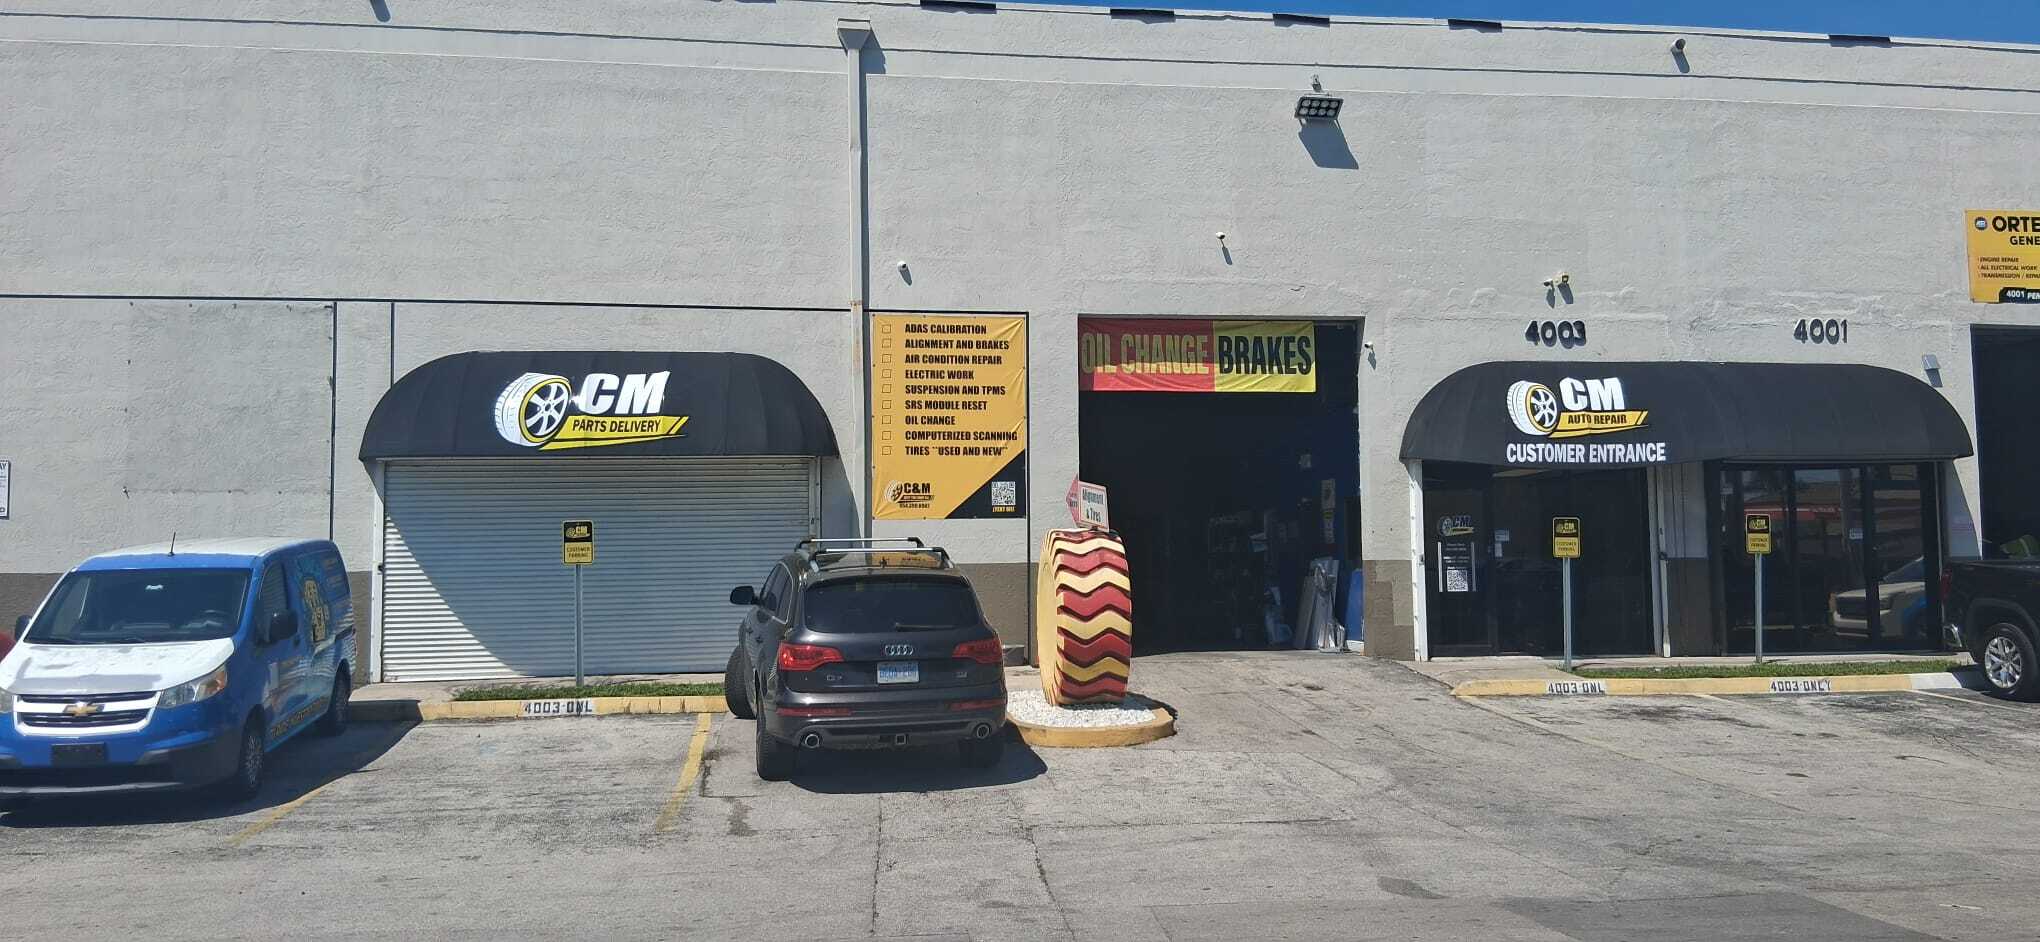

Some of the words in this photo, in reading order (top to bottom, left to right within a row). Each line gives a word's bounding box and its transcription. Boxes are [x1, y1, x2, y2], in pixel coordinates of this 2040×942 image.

[1992, 216, 2040, 232] ORTE
[2010, 236, 2040, 246] GENE
[2006, 290, 2025, 298] 4001
[905, 324, 929, 334] ADAS
[930, 324, 987, 334] CALIBRATION
[1524, 319, 1587, 350] 4003
[1793, 318, 1848, 345] 4001
[905, 339, 954, 349] ALIGNMENT
[956, 339, 974, 349] AND
[976, 340, 1009, 350] BRAKES
[1081, 332, 1117, 373] OIL
[1120, 334, 1209, 375] CHANGE
[1218, 335, 1312, 375] BRAKES
[905, 355, 920, 364] AIR
[922, 355, 970, 364] CONDITION
[972, 356, 1002, 365] REPAIR
[905, 370, 945, 379] ELECTRIC
[947, 370, 974, 379] WORK
[578, 371, 671, 415] CM
[905, 385, 960, 395] SUSPENSION
[962, 385, 980, 395] AND
[981, 385, 1006, 395] TPMS
[1559, 376, 1625, 411] CM
[905, 400, 923, 410] SRS
[924, 400, 960, 410] MODULE
[961, 400, 988, 410] RESET
[905, 415, 919, 425] OIL
[920, 415, 956, 425] CHANGE
[1568, 413, 1592, 424] AUTO
[1594, 414, 1628, 425] REPAIR
[572, 419, 607, 432] PARTS
[609, 419, 662, 433] DELIVERY
[905, 431, 972, 440] COMPUTERIZED
[973, 431, 1018, 440] SCANNING
[905, 446, 930, 456] TIRES
[962, 446, 980, 456] AND
[1506, 443, 1585, 463] CUSTOMER
[1589, 442, 1666, 463] ENTRANCE
[903, 482, 931, 494] C&M
